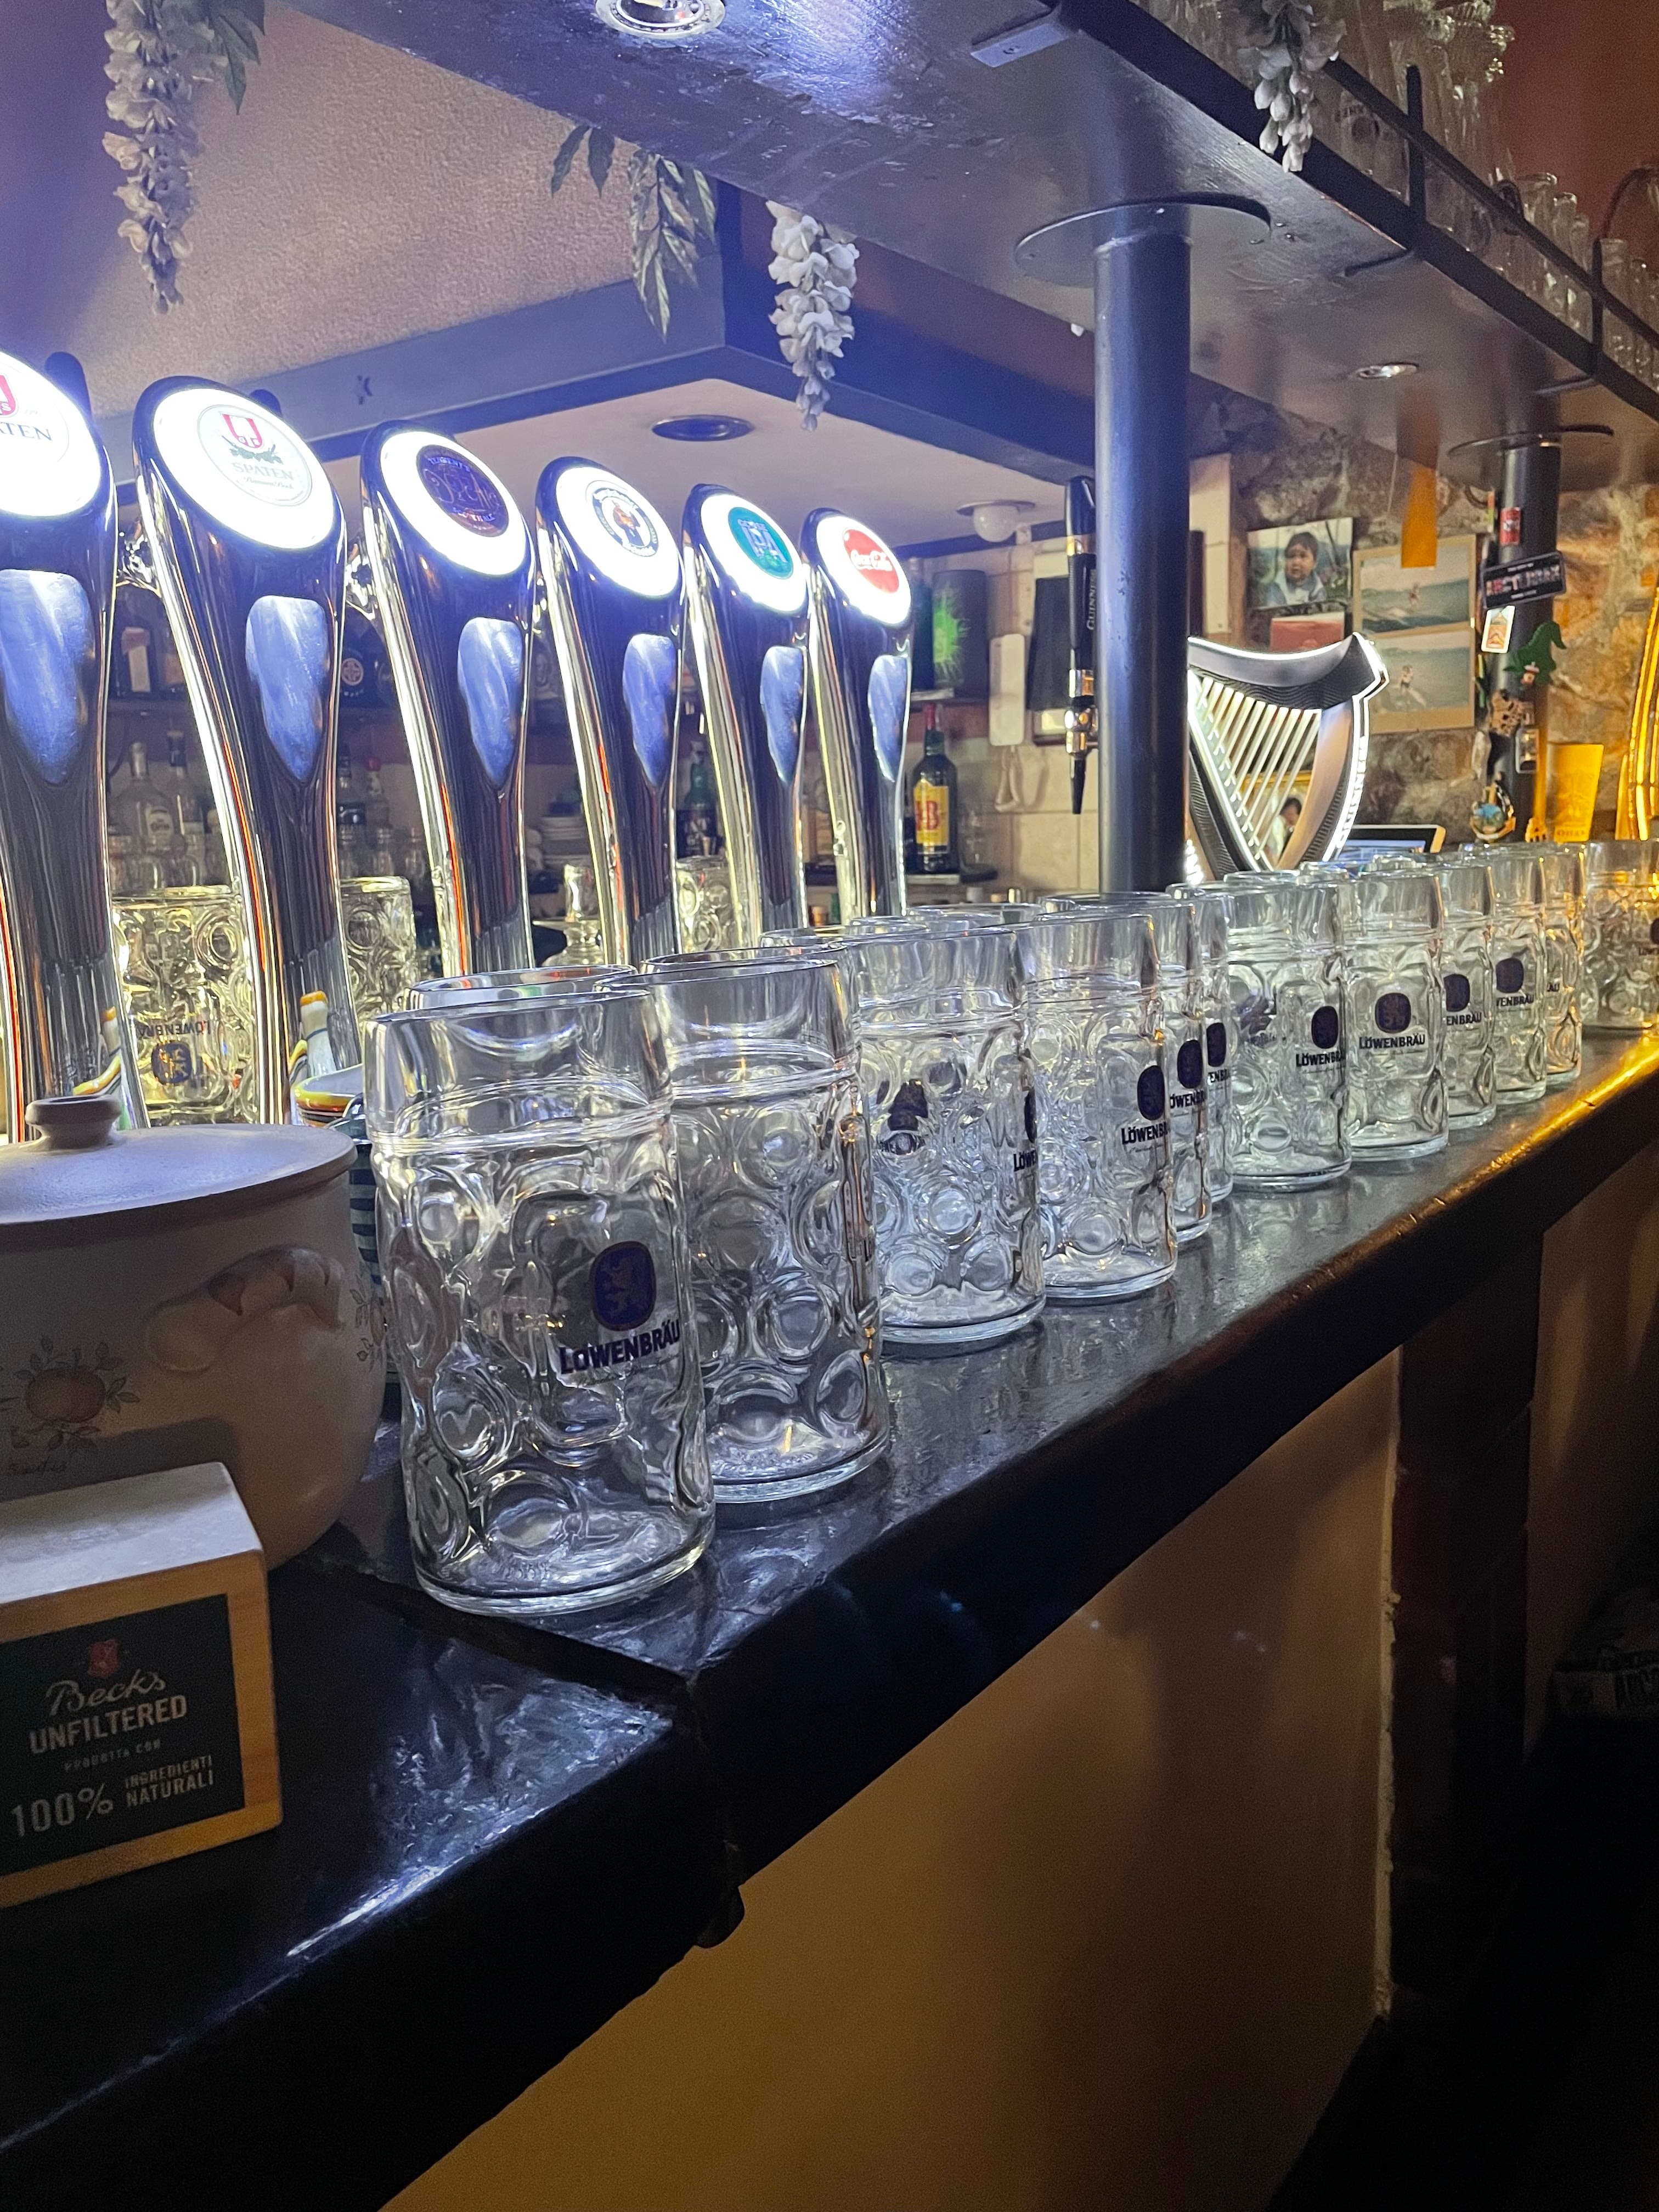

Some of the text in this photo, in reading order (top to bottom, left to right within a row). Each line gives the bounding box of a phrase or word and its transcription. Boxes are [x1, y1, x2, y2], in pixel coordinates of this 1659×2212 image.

[232, 462, 295, 481] SPATEN
[1359, 1032, 1425, 1049] LÖWENBRÄU
[29, 1694, 188, 1755] UNFILTERED
[124, 1755, 212, 1789] INGREDIENTI
[125, 1769, 214, 1807] NATURALI
[12, 1782, 114, 1837] 100%
